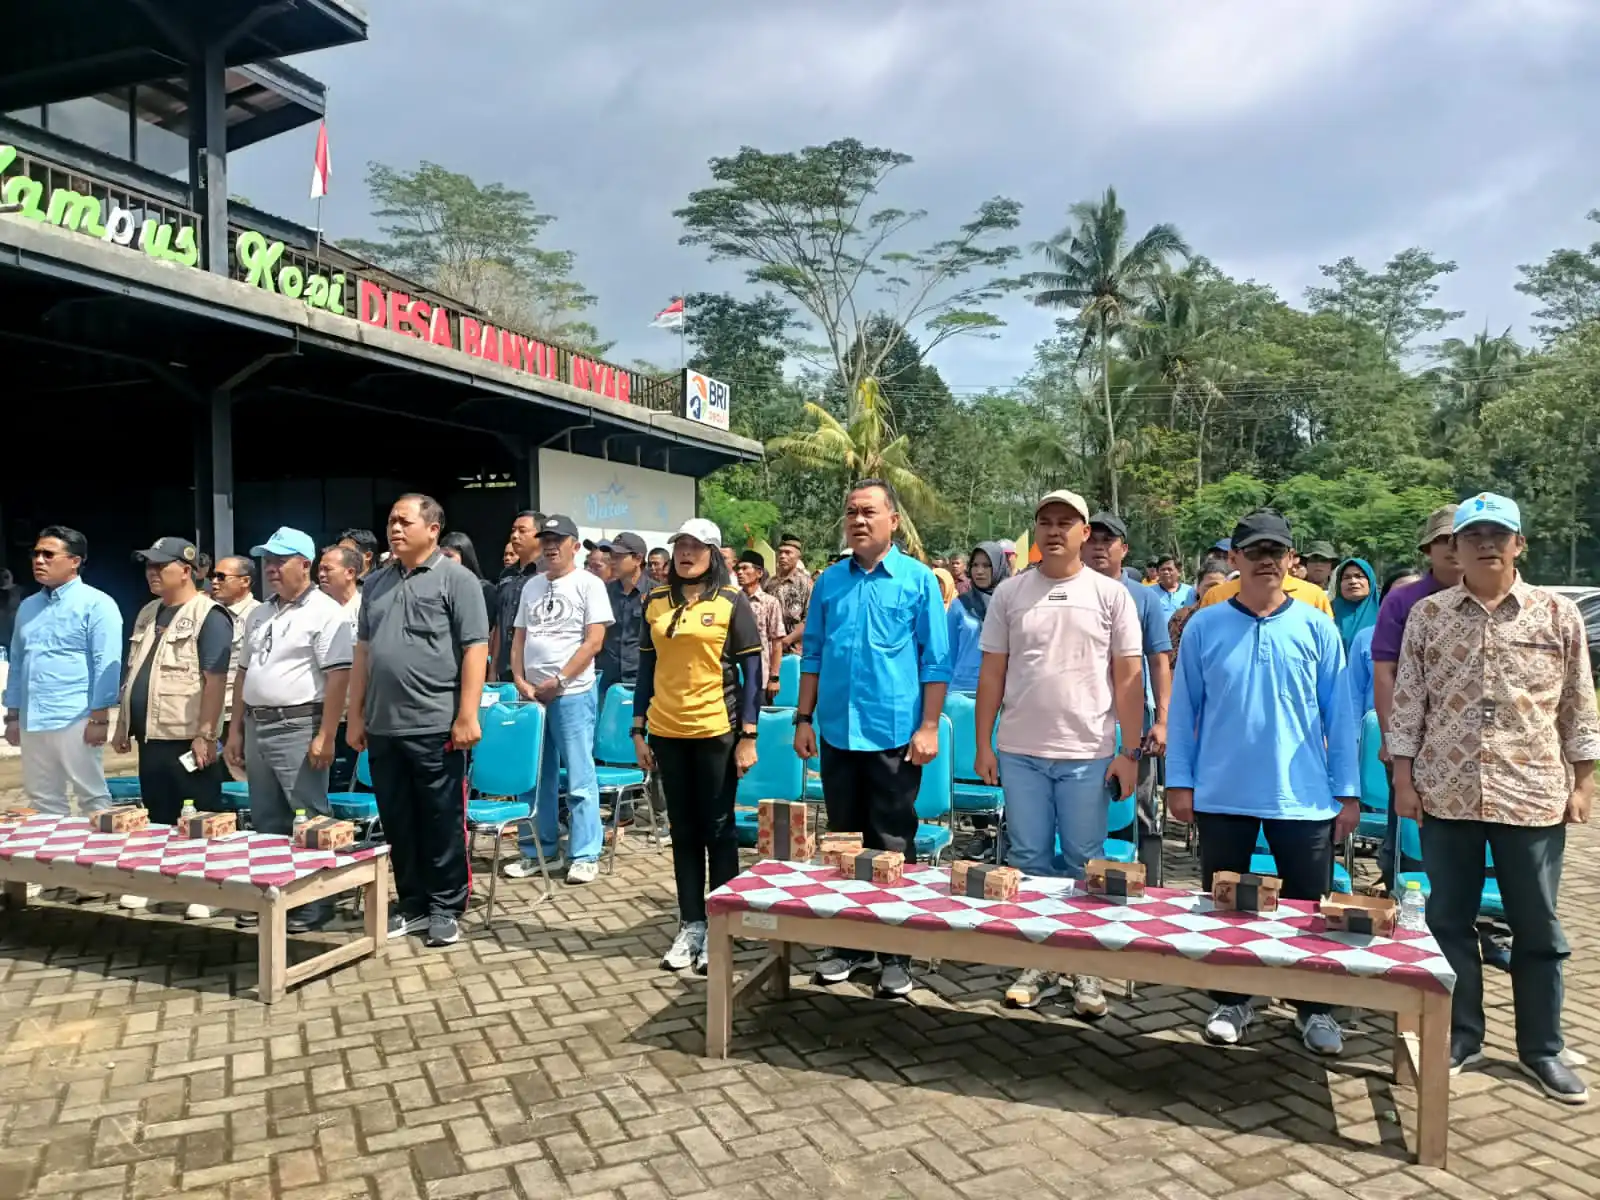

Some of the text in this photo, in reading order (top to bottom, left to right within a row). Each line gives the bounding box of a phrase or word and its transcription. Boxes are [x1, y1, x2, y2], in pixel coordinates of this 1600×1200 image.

[238, 231, 345, 315] Kopi
[360, 280, 631, 404] DESA BANYU NYAR
[709, 380, 727, 411] BRI
